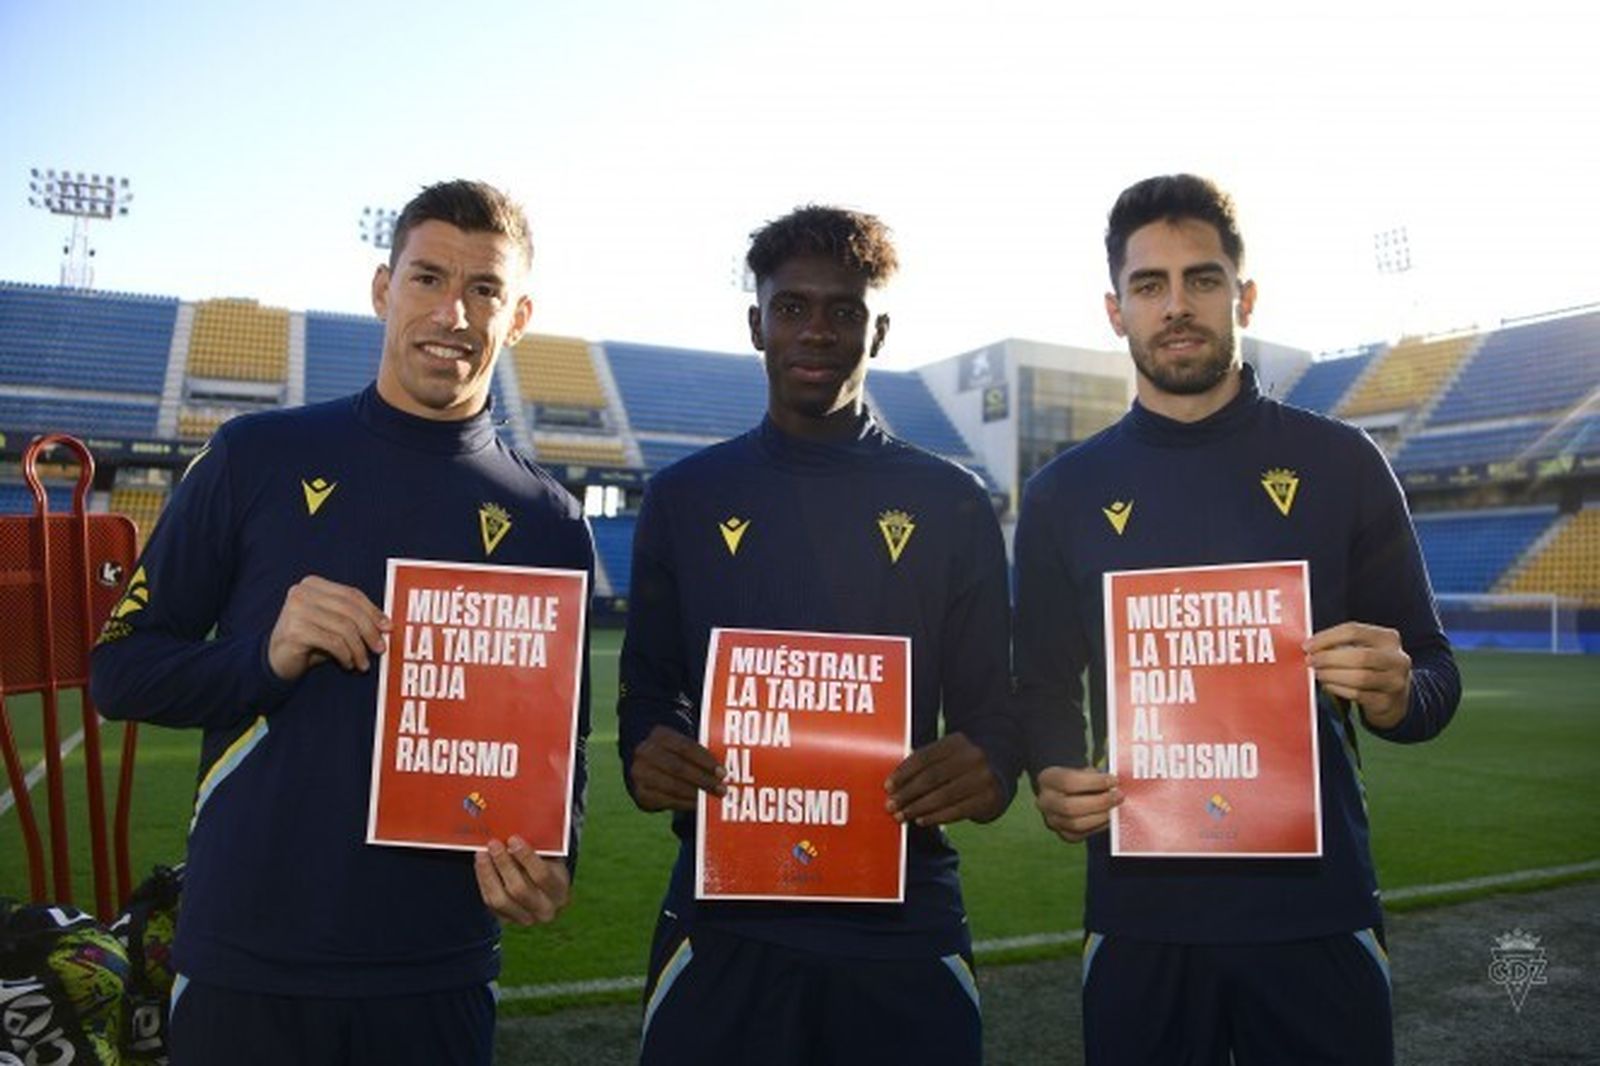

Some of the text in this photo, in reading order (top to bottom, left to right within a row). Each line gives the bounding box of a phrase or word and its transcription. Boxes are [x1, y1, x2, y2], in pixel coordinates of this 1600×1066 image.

[407, 586, 559, 632] MUÉSTRALE
[1126, 588, 1282, 630] MUÉSTRALE
[403, 626, 547, 668] LA TARJETA
[730, 645, 883, 682] MUÉSTRALE
[1129, 628, 1276, 667] LA TARJETA
[401, 663, 465, 700] ROJA
[726, 677, 875, 713] LA TARJETA
[1130, 669, 1196, 704] ROJA
[399, 701, 429, 735] AL
[723, 710, 791, 747] ROJA
[1132, 708, 1164, 742] AL
[396, 737, 520, 779] RACISMO
[723, 749, 755, 784] AL
[1133, 742, 1258, 779] RACISMO
[721, 786, 849, 825] RACISMO
